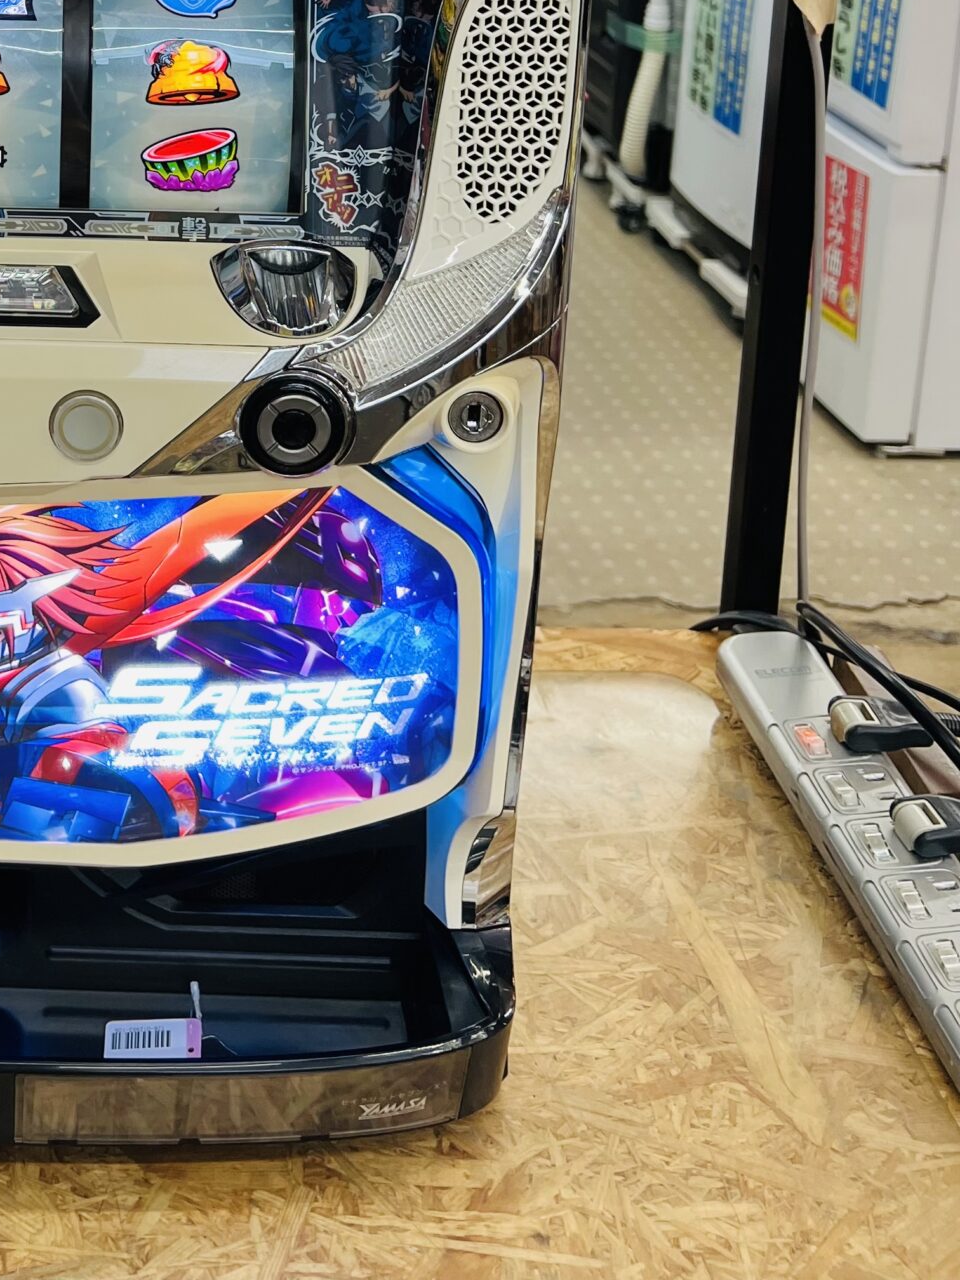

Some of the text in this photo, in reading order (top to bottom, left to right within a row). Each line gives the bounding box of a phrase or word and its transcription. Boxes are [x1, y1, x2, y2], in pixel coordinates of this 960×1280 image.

[94, 663, 431, 719] SACRED
[111, 706, 417, 768] SEVEN
[358, 1096, 428, 1120] YAMASA
